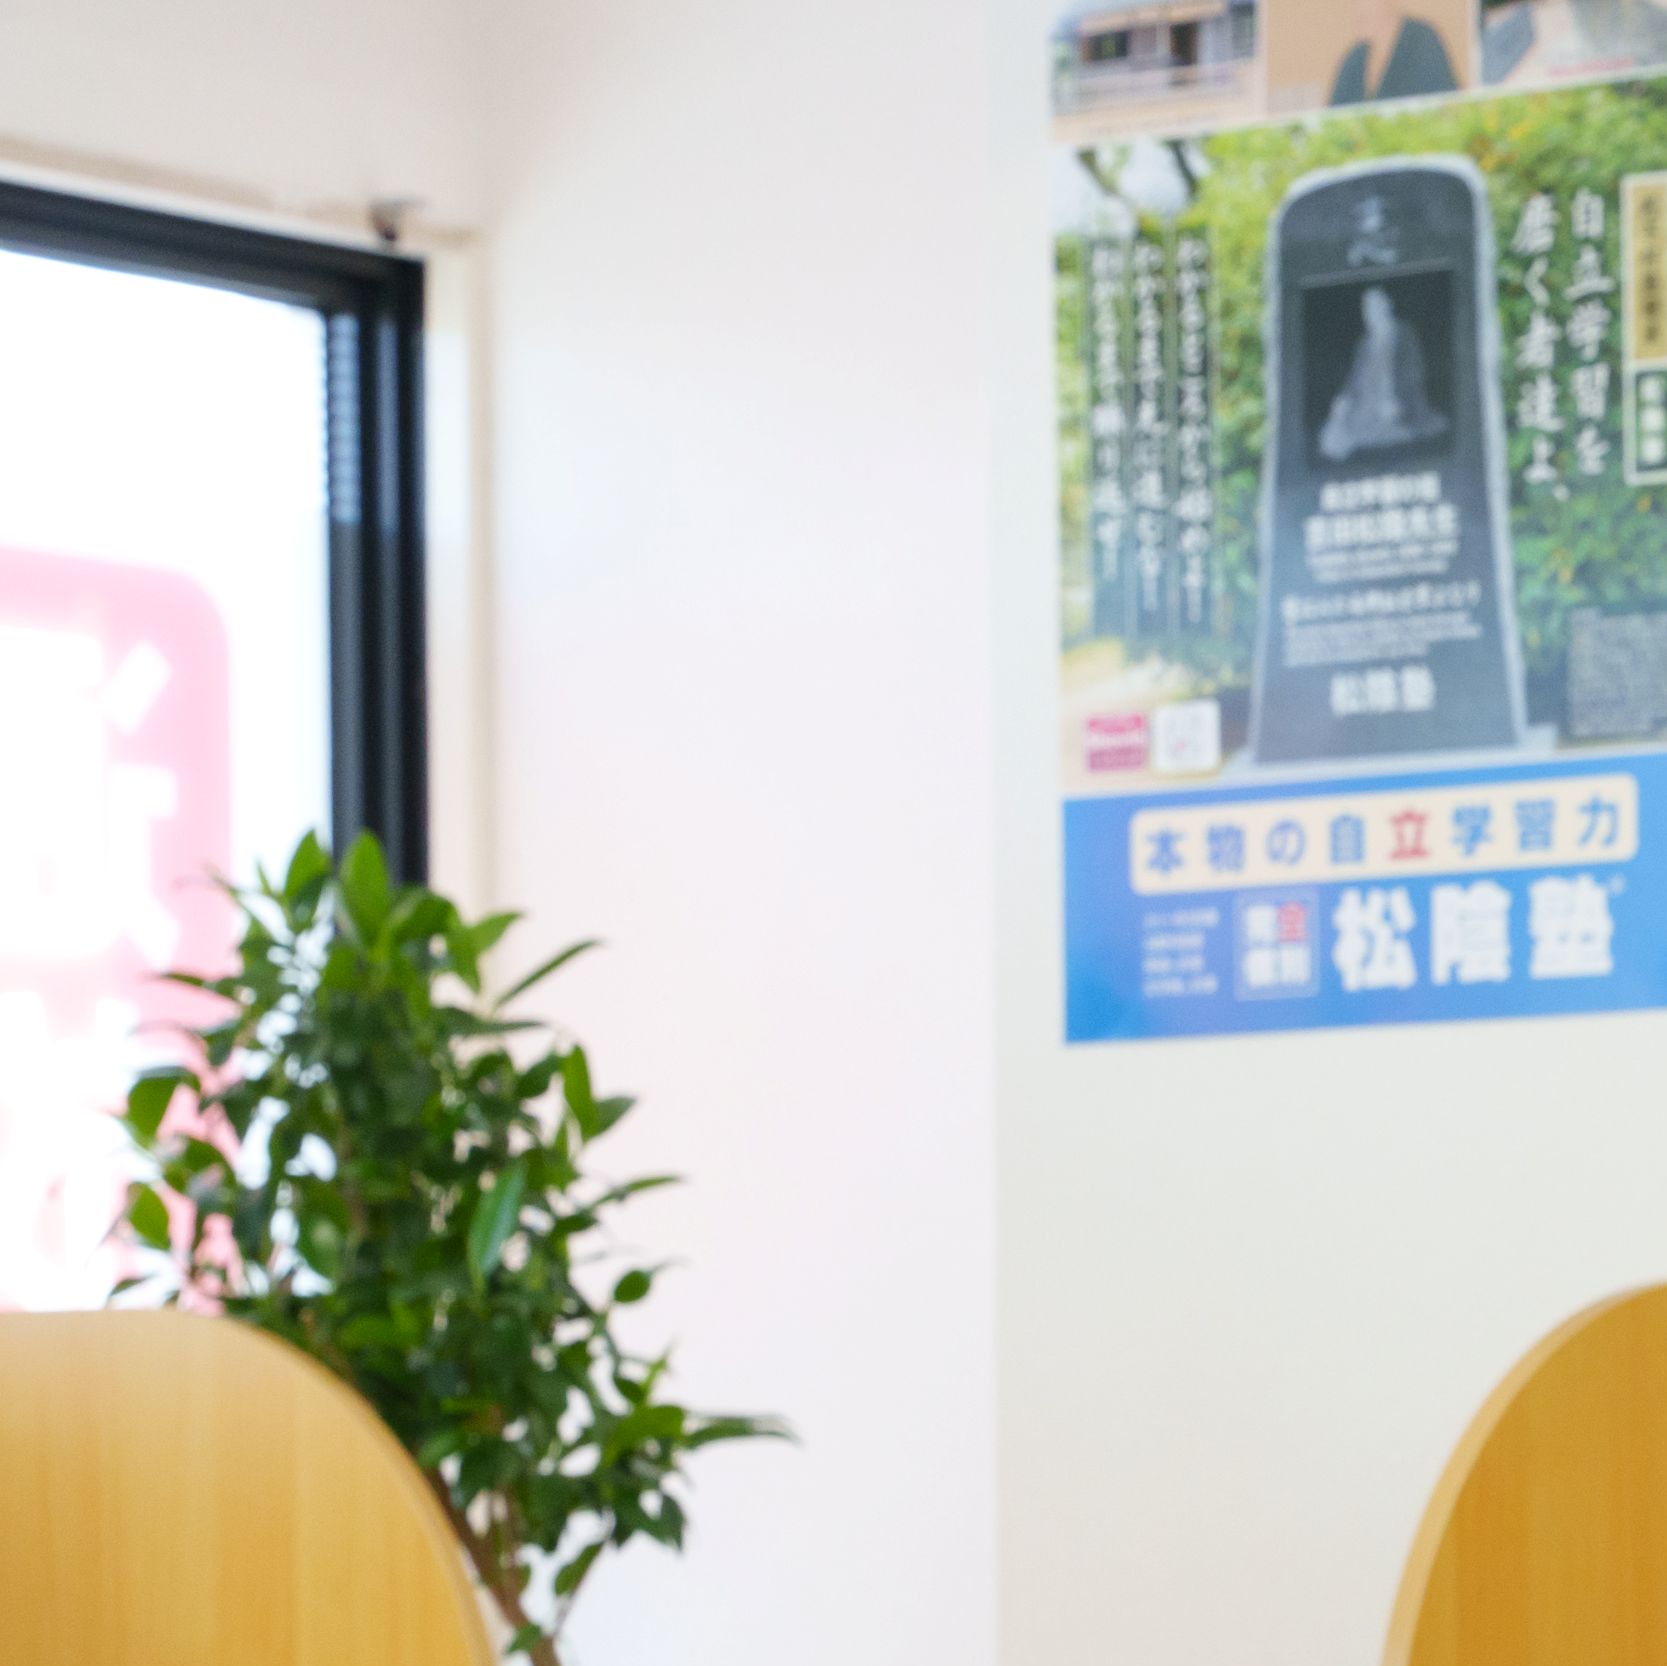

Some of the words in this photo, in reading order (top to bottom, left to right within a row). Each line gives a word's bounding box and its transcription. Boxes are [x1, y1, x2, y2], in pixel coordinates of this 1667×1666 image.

[1144, 796, 1621, 876] 本物の自立学習力
